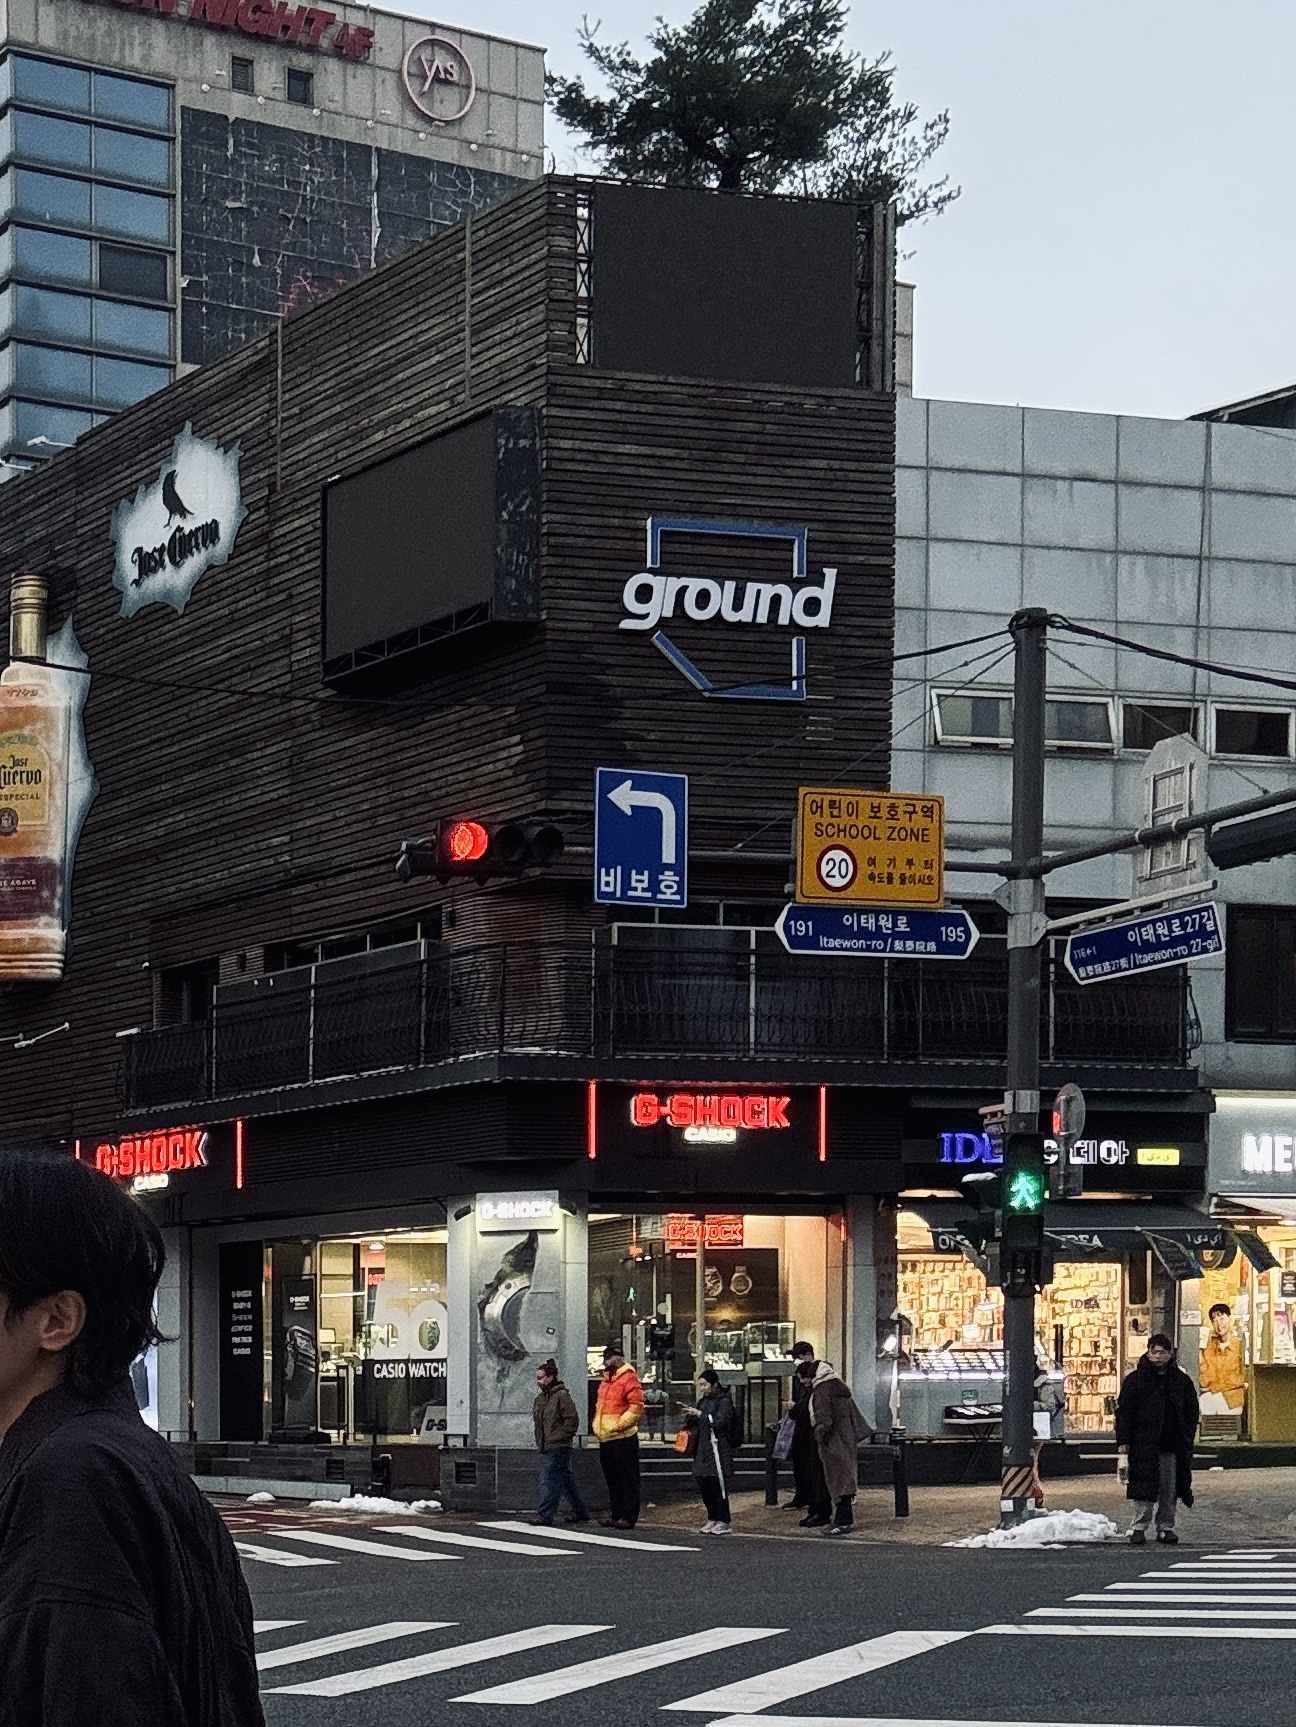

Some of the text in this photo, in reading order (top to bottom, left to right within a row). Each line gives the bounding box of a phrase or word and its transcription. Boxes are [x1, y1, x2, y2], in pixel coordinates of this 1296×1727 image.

[190, 0, 337, 46] NIGHT
[130, 518, 220, 588] Jose Cuervo
[618, 567, 839, 631] ground
[809, 797, 935, 823] 어린이 보호구역
[813, 821, 931, 843] SCHOOL ZONE
[825, 857, 850, 879] 20
[600, 865, 682, 901] 비보호
[787, 920, 813, 936] 191
[842, 912, 911, 934] 이태원로
[940, 926, 966, 942] 195
[819, 935, 884, 949] Itaewon-ro
[631, 1092, 792, 1130] G-SHOCK
[683, 1126, 737, 1144] CASIO
[95, 1130, 208, 1178] G-SHOCK
[1241, 1132, 1296, 1173] ME
[481, 1200, 554, 1219] G-SHOCK
[373, 1360, 447, 1379] CASIO WATCH
